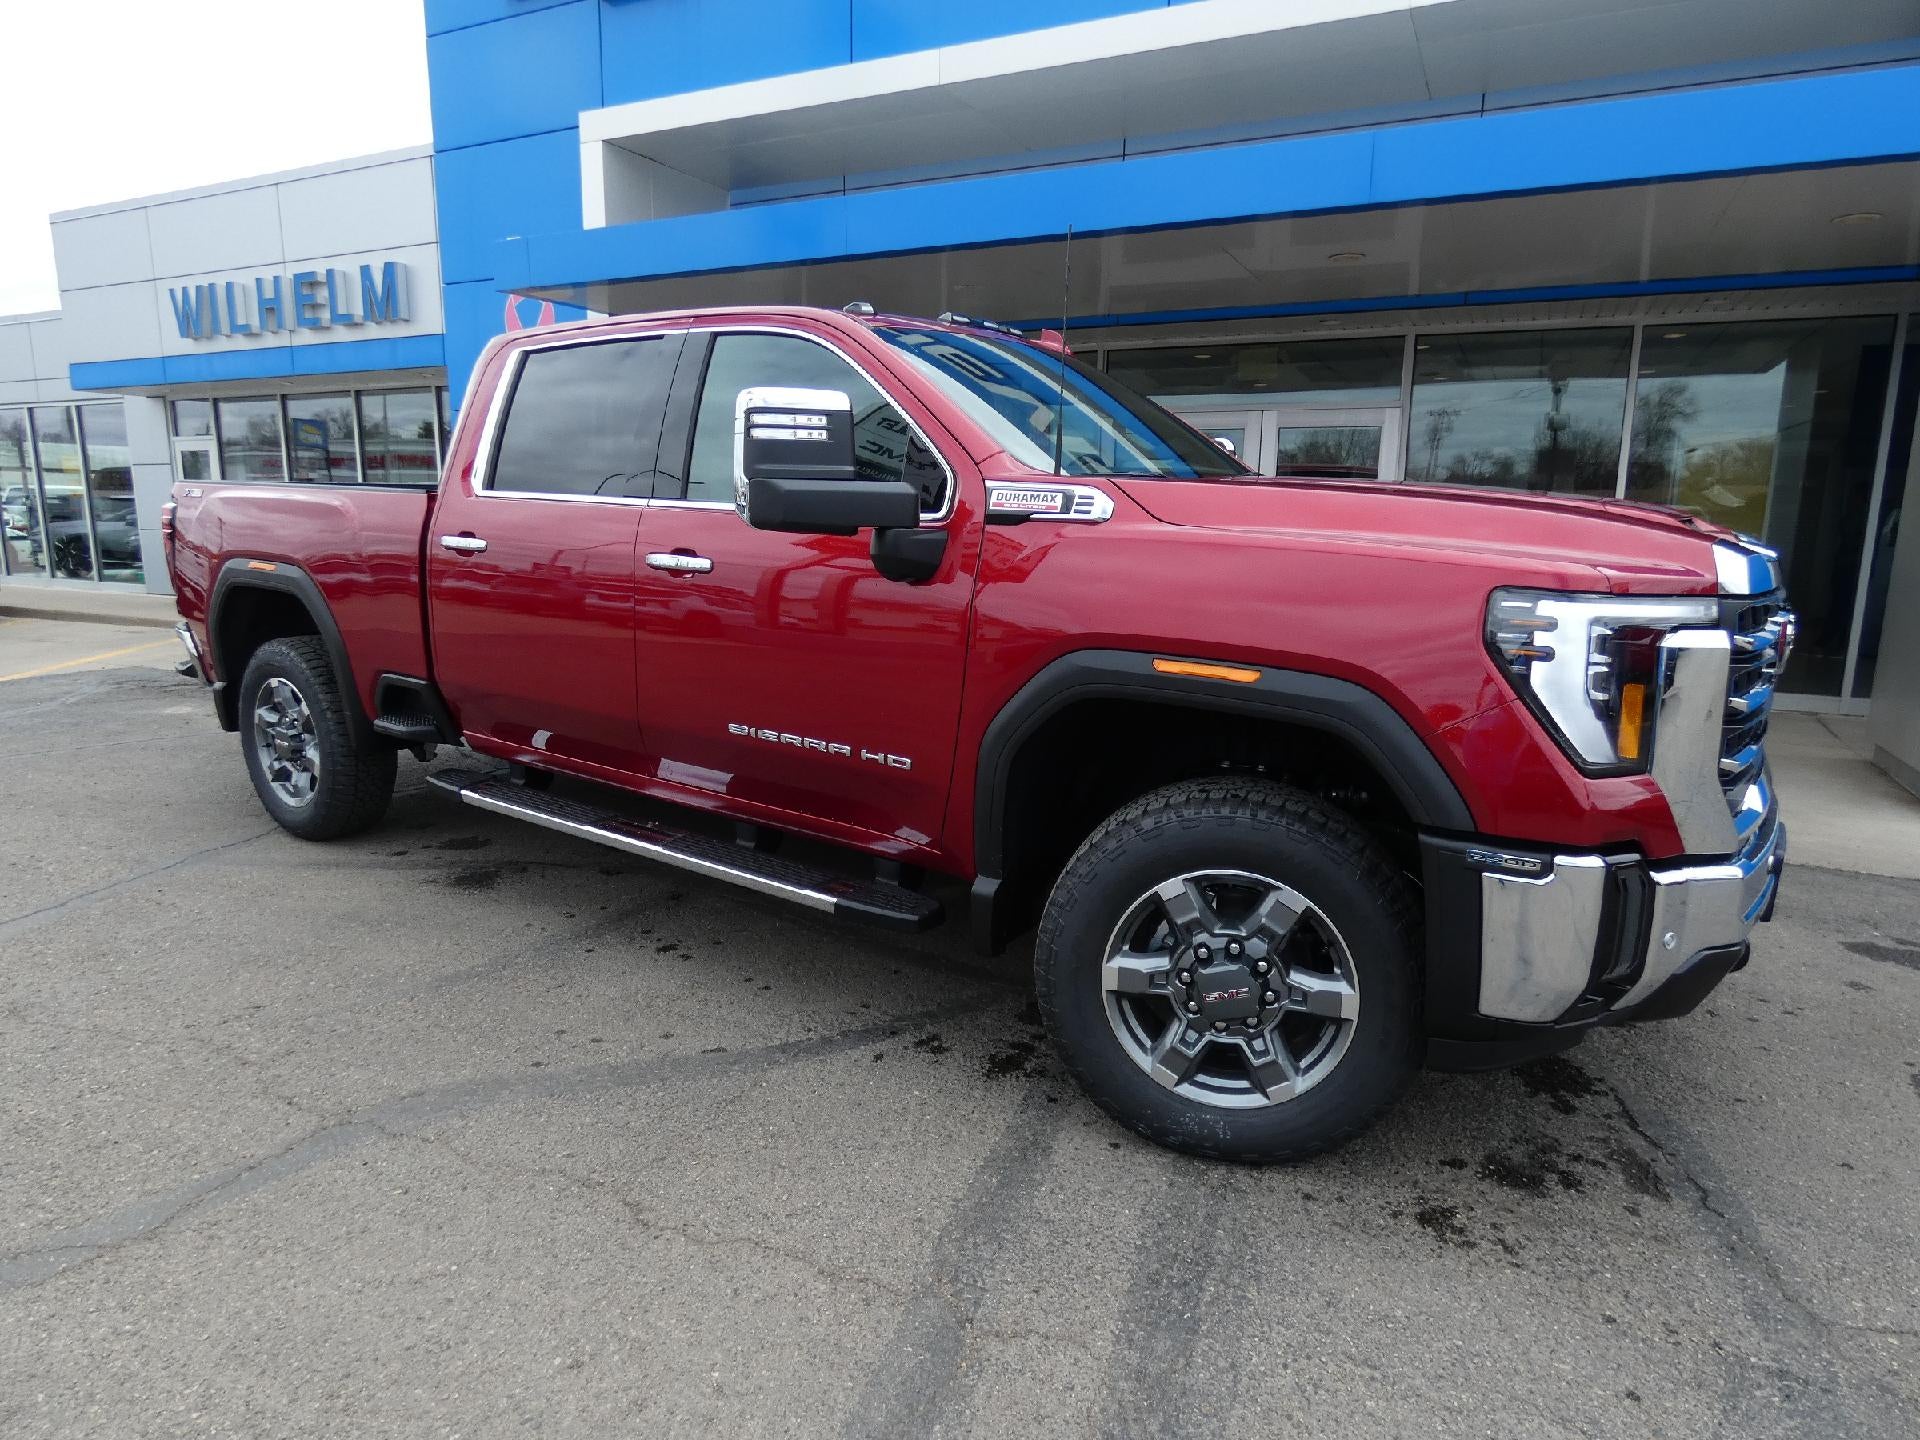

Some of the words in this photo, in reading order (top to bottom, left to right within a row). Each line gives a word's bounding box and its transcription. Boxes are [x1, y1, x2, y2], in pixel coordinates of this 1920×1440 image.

[168, 261, 405, 339] WILHELM
[996, 492, 1058, 503] DURAMAX
[728, 723, 852, 757] SIERRA
[860, 749, 912, 770] HD
[1202, 987, 1249, 1003] GMC
